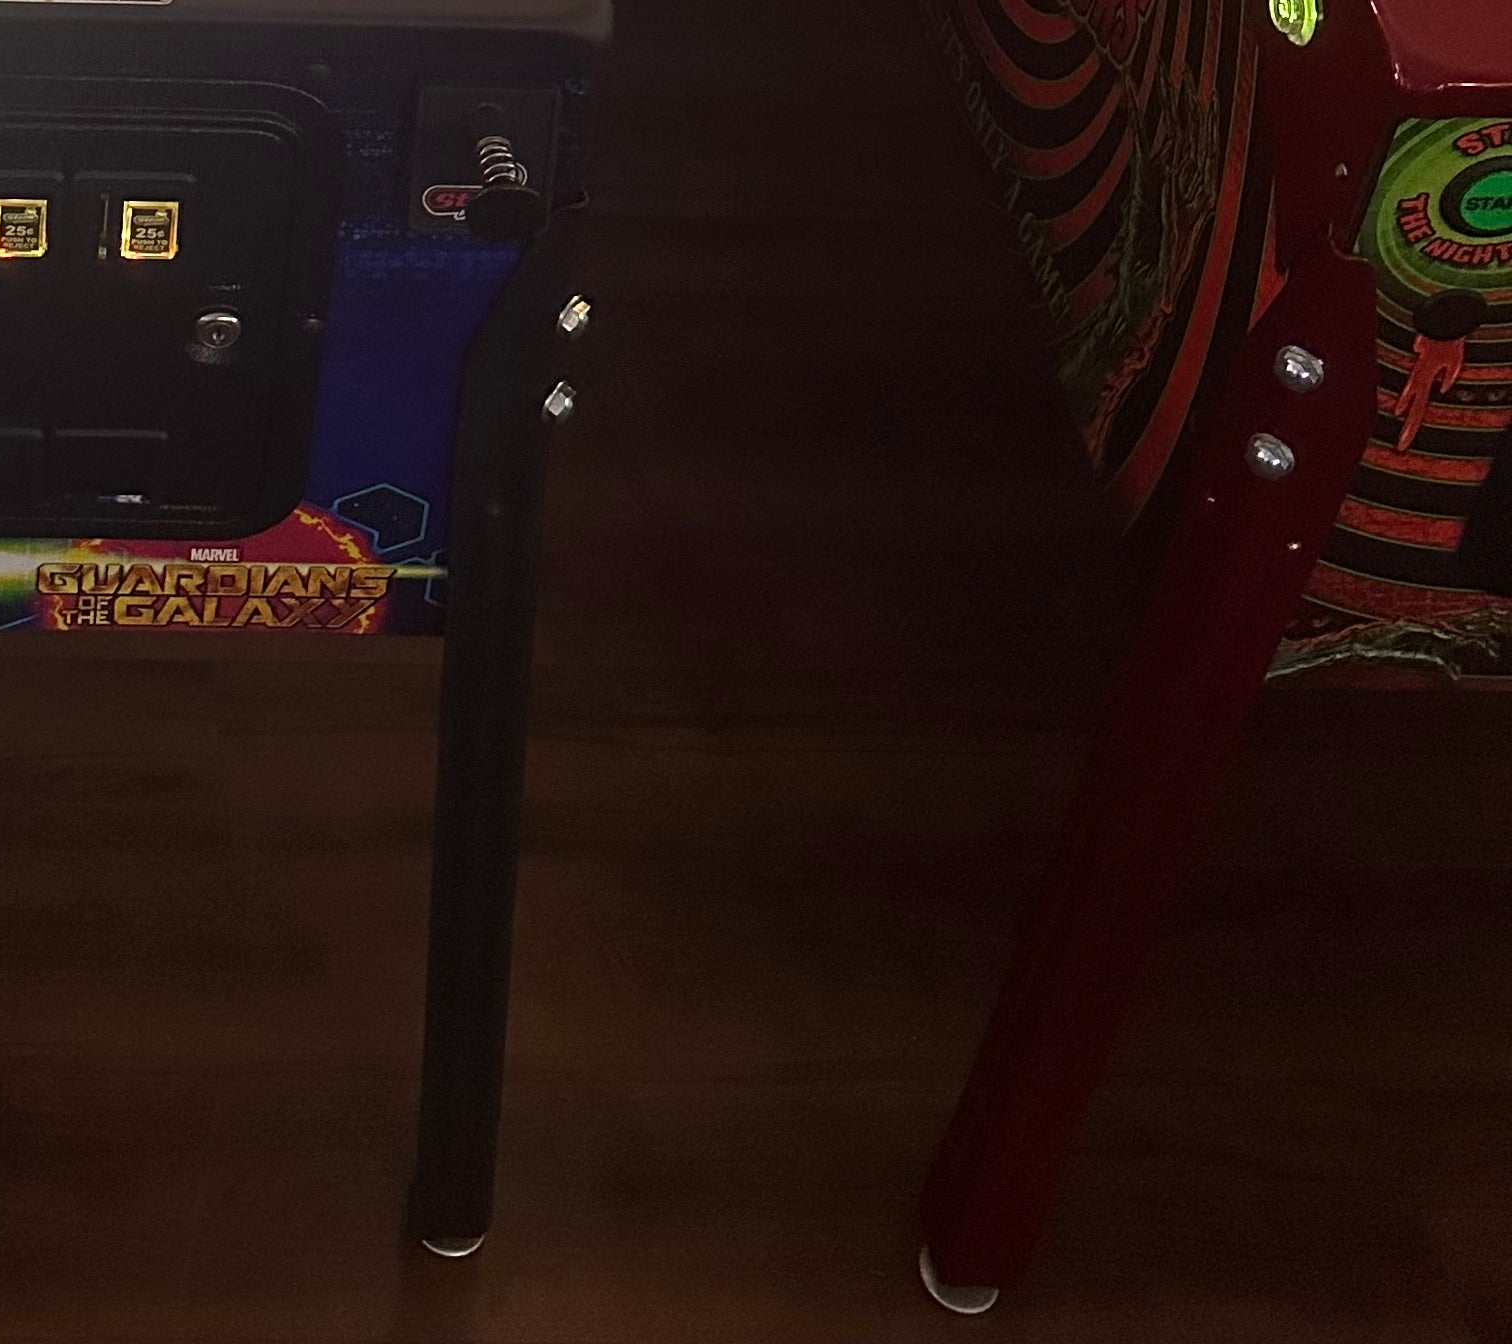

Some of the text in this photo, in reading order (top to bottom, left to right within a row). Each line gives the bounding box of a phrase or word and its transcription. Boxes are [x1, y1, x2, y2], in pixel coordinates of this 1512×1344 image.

[1396, 192, 1436, 245] THE
[5, 224, 34, 236] 25¢
[135, 227, 165, 239] 25¢
[1419, 236, 1512, 265] NIGHT
[190, 548, 239, 562] MARVEL
[38, 562, 397, 598] GUARDIANS
[62, 596, 376, 627] THE GALAXY
[79, 596, 113, 610] OF
